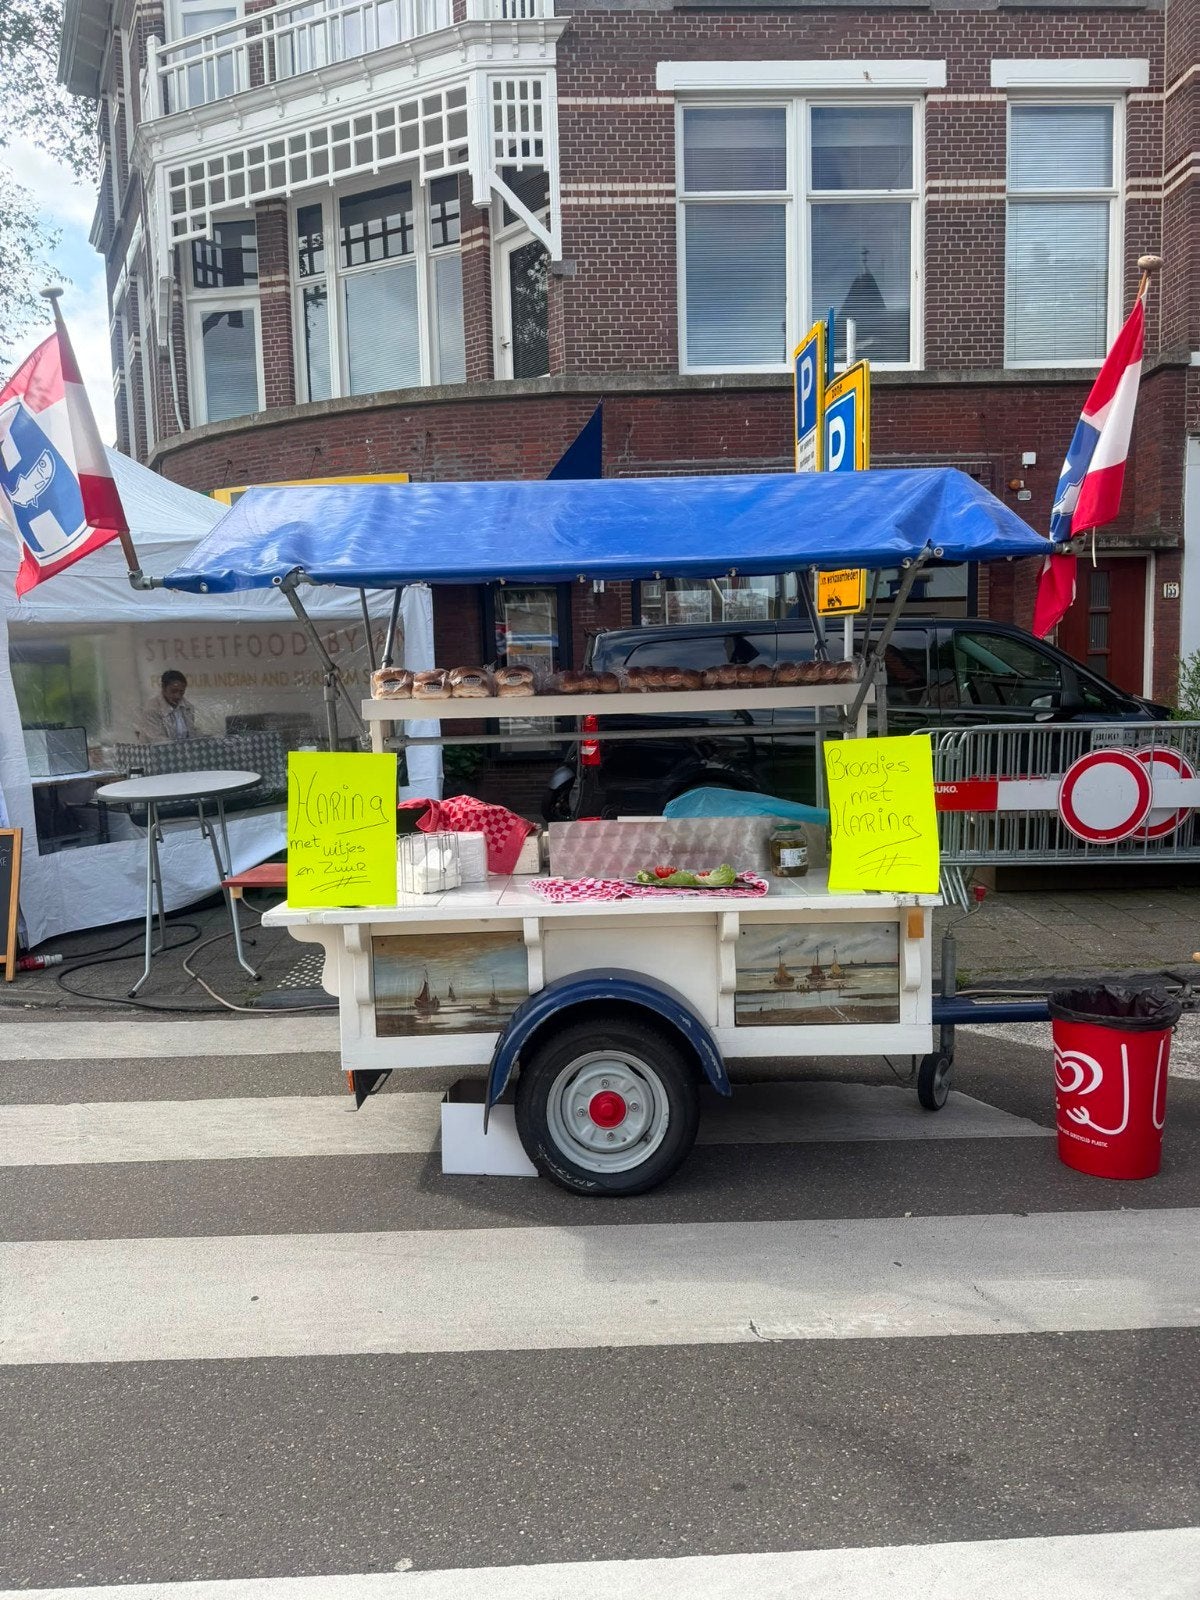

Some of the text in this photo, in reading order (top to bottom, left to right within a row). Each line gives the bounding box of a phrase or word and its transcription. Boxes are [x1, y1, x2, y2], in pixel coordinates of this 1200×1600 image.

[801, 355, 813, 429] P
[144, 632, 308, 662] STREETFOOD
[327, 628, 358, 655] BY
[827, 748, 910, 788] Broodjes
[850, 786, 893, 805] met
[290, 835, 366, 864] met uitjes
[296, 866, 315, 877] en
